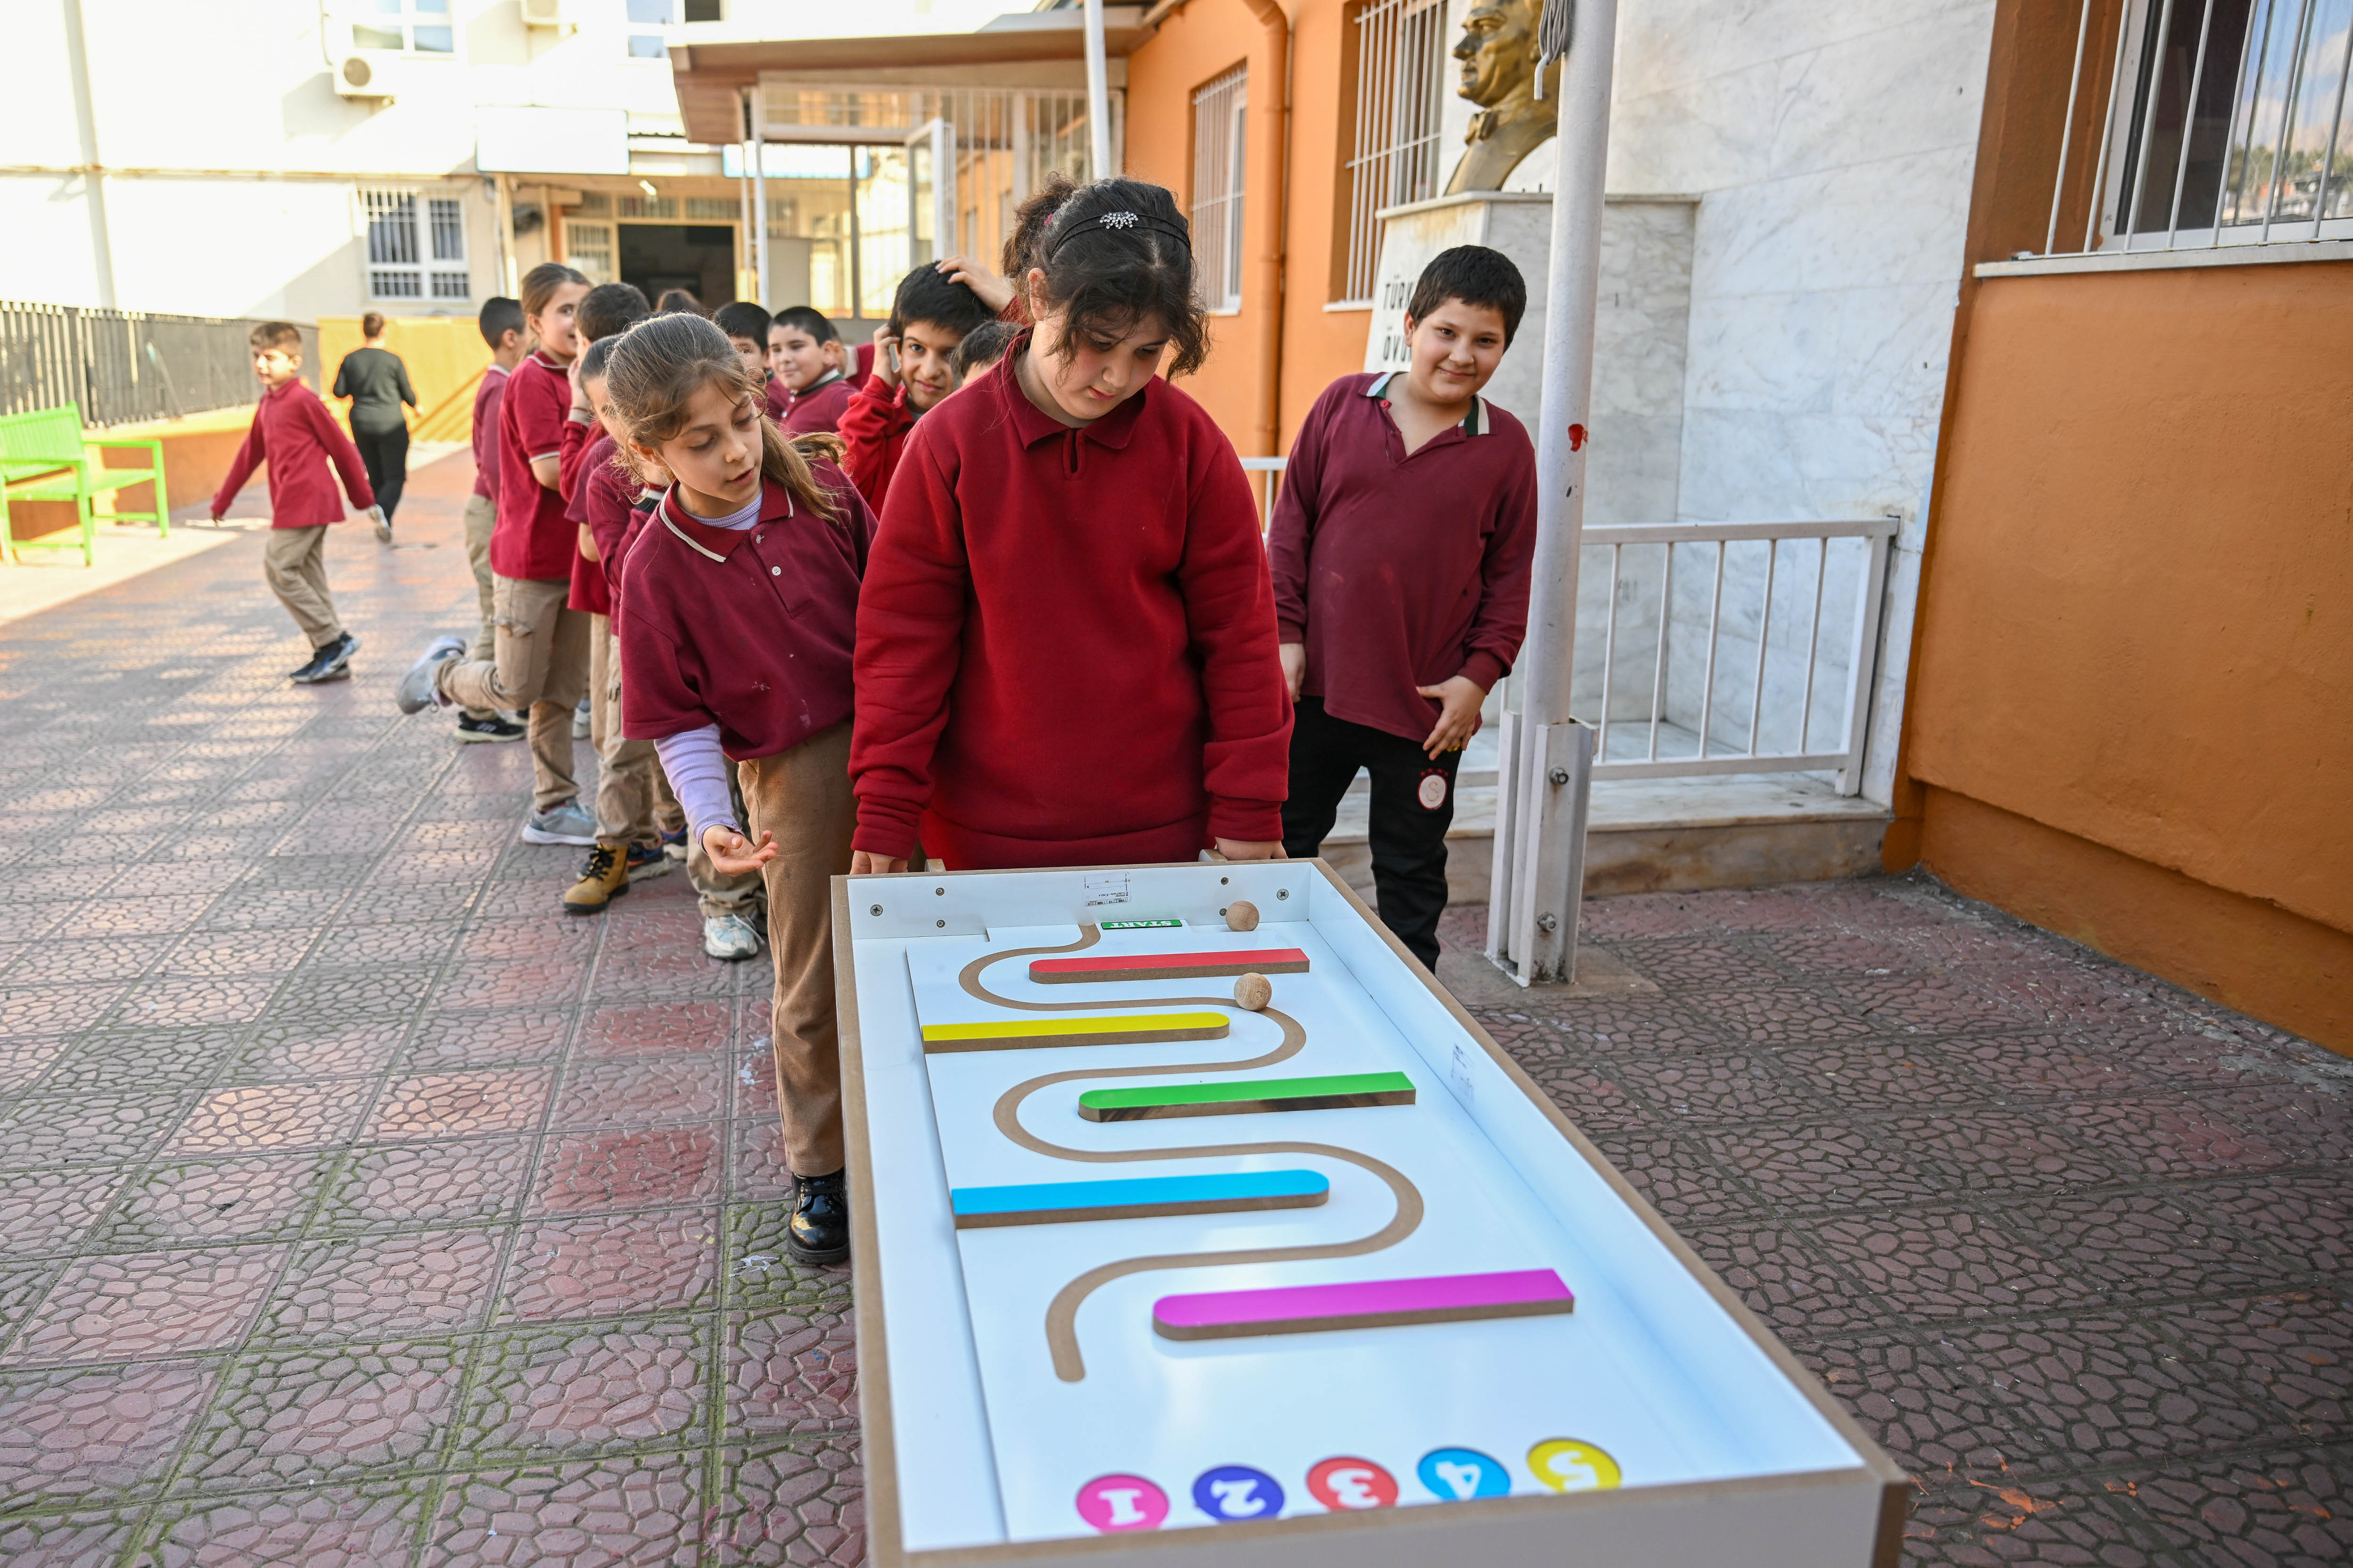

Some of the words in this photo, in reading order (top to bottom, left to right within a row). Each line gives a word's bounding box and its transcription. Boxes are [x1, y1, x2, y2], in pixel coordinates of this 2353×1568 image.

[1326, 1468, 1380, 1508] 3
[1435, 1461, 1482, 1501] 4
[1547, 1450, 1599, 1493] 5
[1098, 1488, 1146, 1526] 1
[1210, 1479, 1267, 1518] 2
